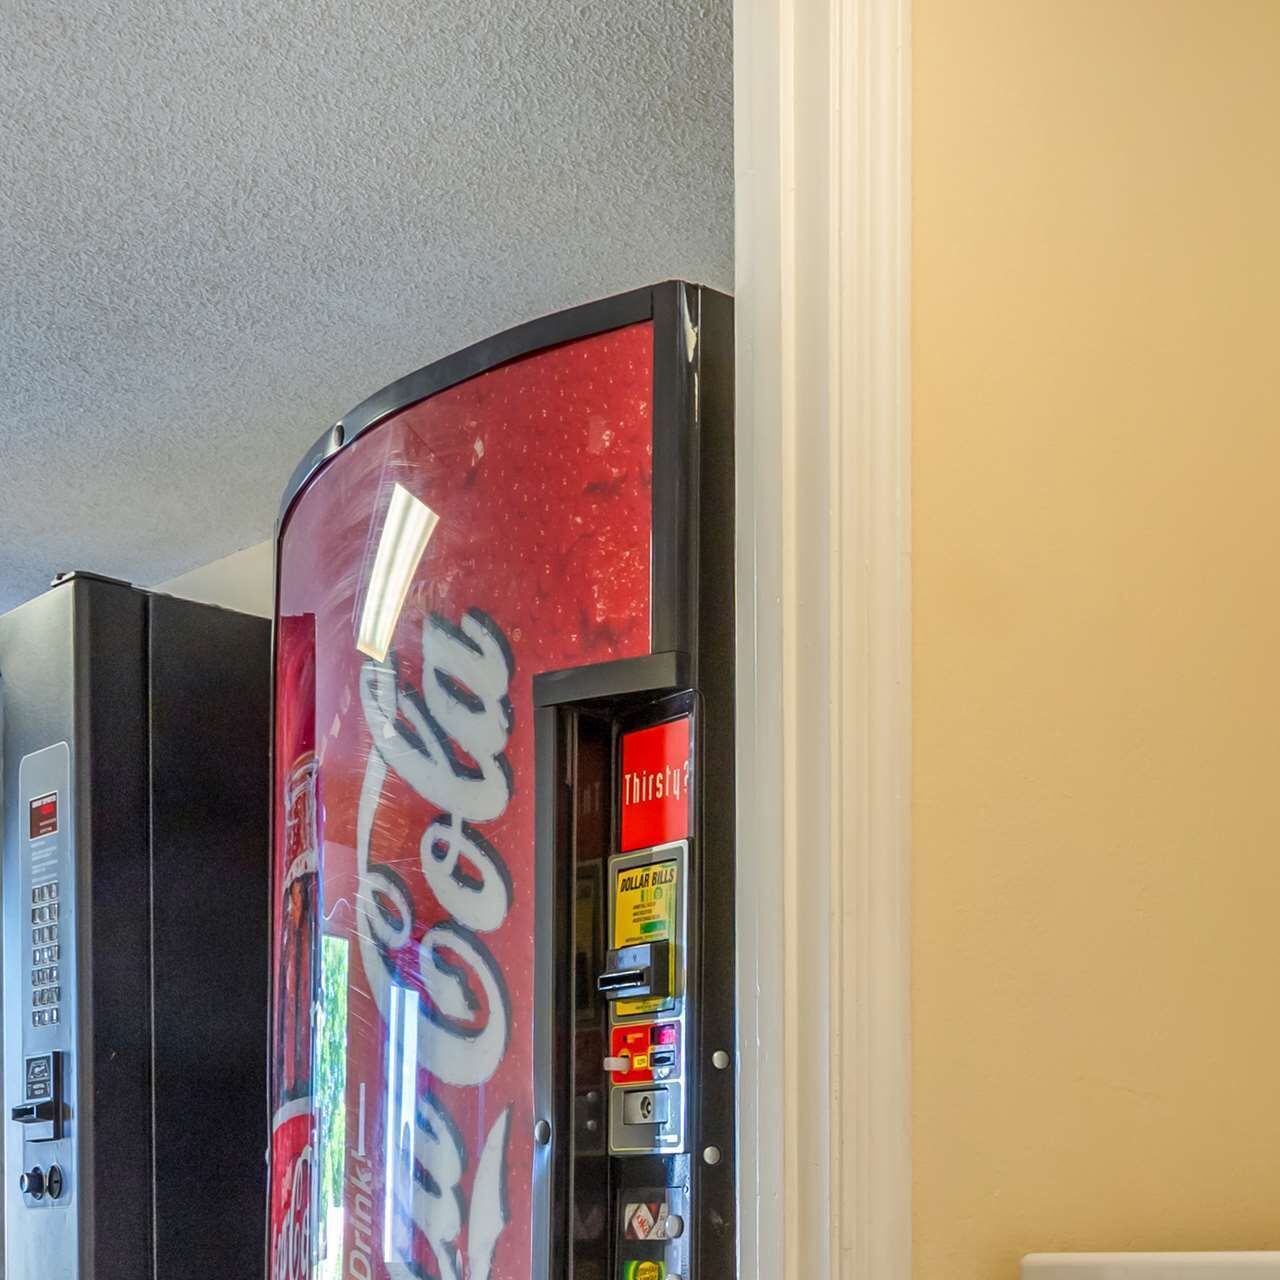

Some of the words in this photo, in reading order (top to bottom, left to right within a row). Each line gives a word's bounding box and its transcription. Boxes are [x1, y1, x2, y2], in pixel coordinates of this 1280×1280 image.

[624, 760, 689, 806] Thirsty?
[620, 873, 650, 892] DOLLAR
[652, 868, 675, 886] BILLS
